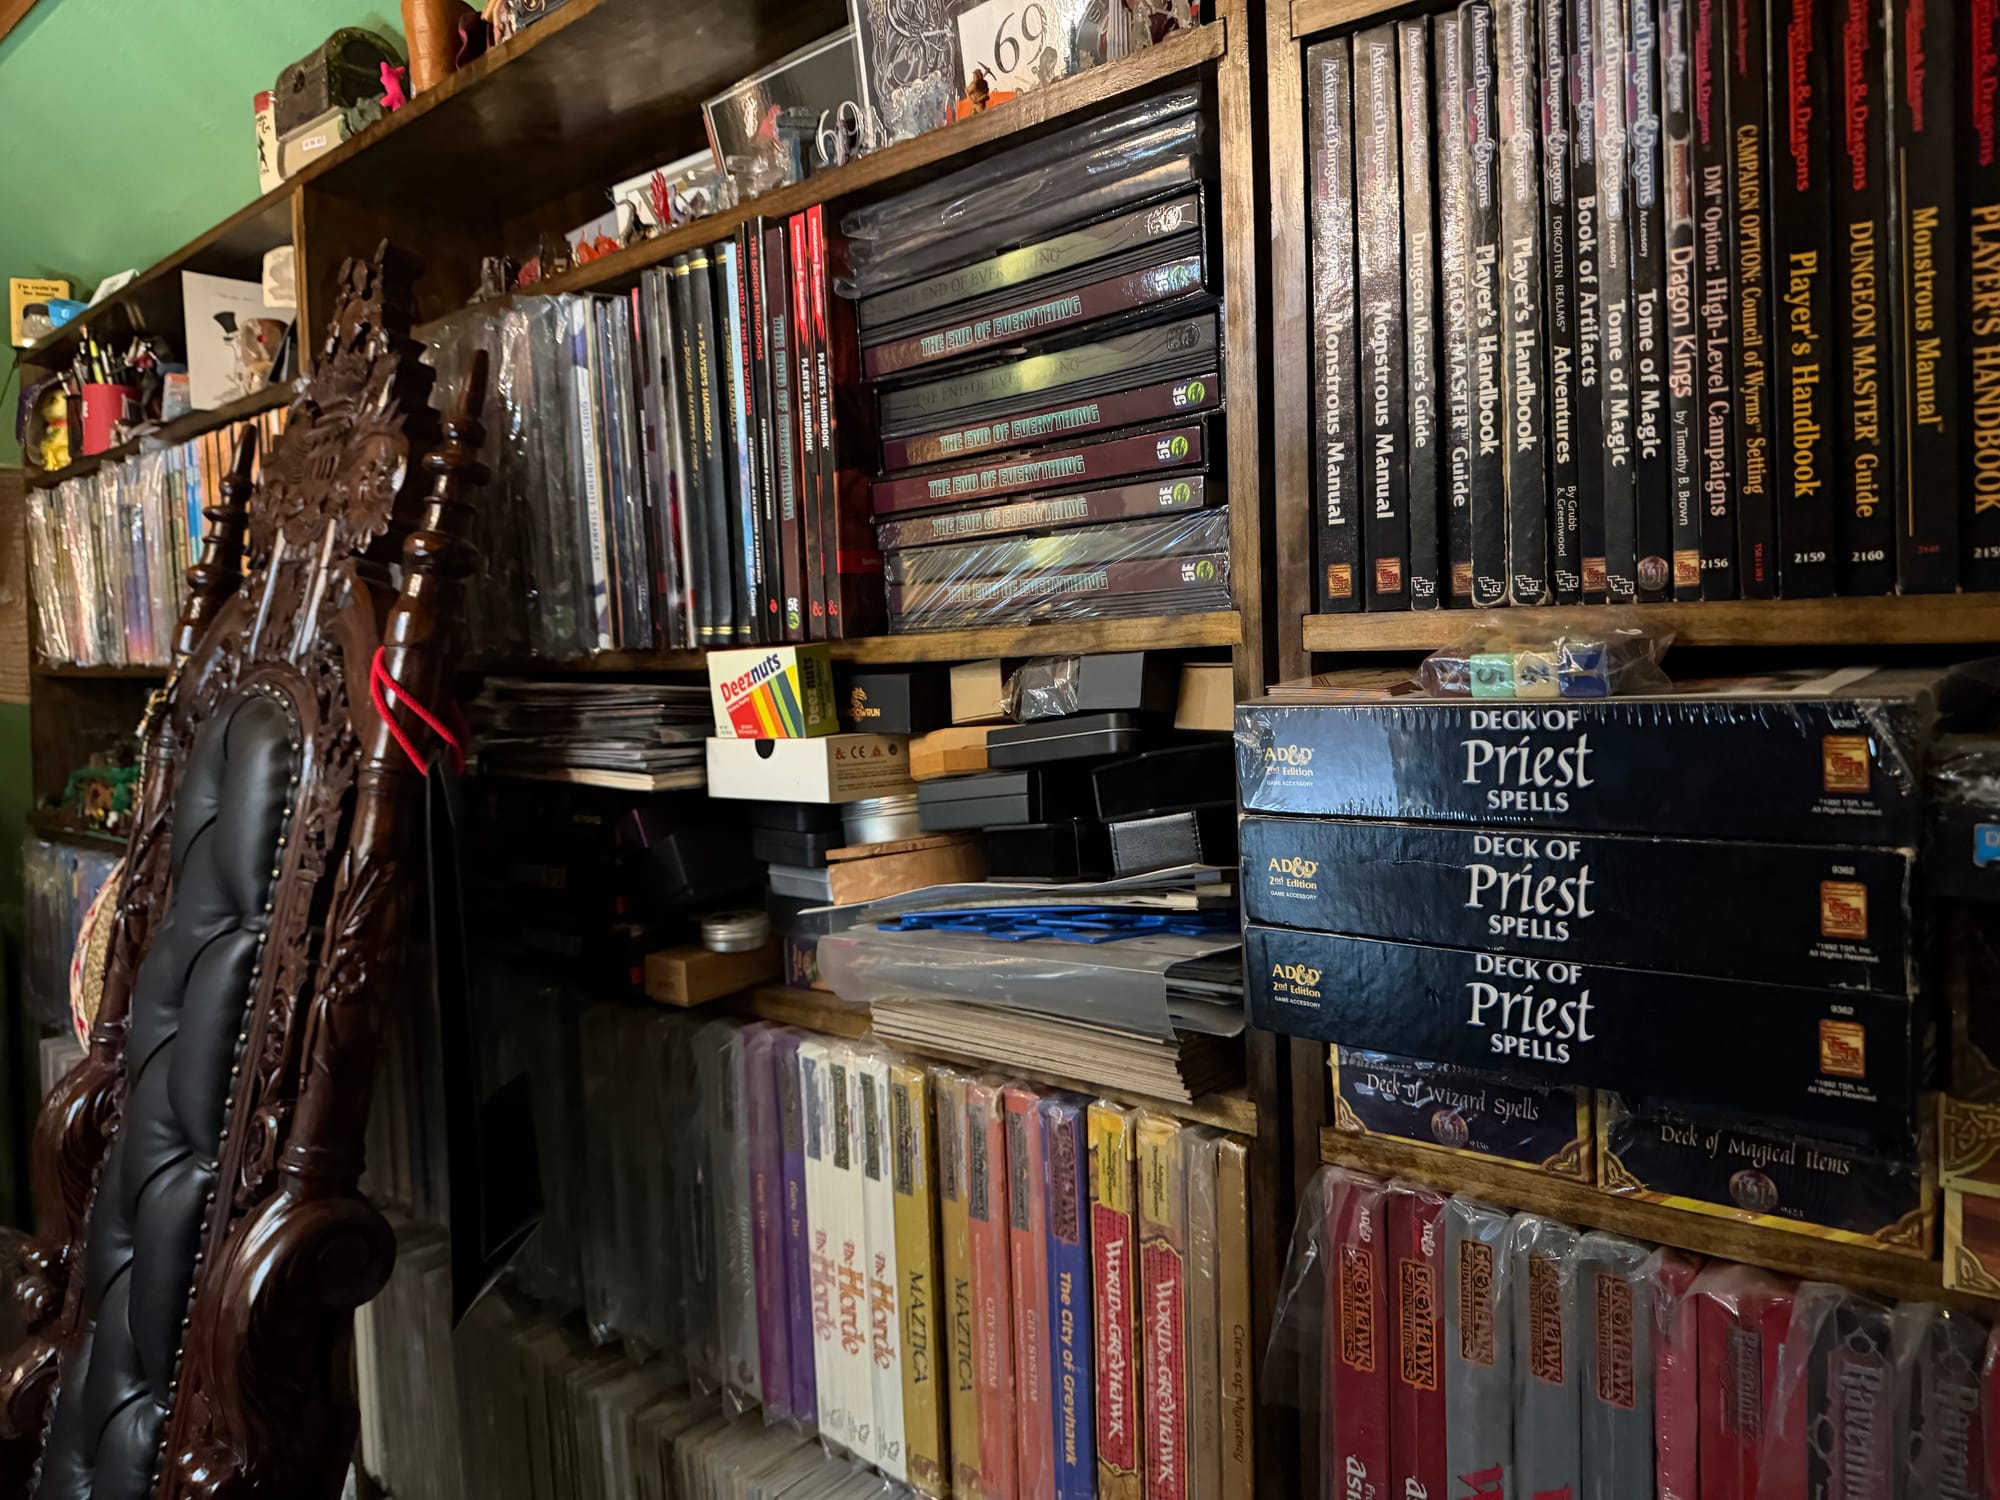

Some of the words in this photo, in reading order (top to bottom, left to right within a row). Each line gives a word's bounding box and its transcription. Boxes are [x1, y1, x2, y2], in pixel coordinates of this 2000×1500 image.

[1409, 30, 1424, 84] Advanced
[1474, 8, 1489, 76] Advanced
[1633, 38, 1654, 121] Dungeons
[1474, 77, 1489, 144] Dungeons
[1474, 154, 1490, 208] Dragons
[1633, 134, 1654, 205] Dragons
[1736, 124, 1759, 211] CAMPAIGN
[1577, 194, 1597, 255] Book
[1608, 222, 1618, 269] Accessory
[1639, 210, 1649, 258] Accessory
[1701, 206, 1723, 272] Option:
[1739, 213, 1761, 283] OPTION:
[738, 275, 746, 303] LAND
[751, 260, 760, 303] BORDER
[1410, 231, 1427, 315] Dungeon
[1472, 245, 1496, 328] Player's
[1512, 236, 1535, 324] Player's
[1578, 258, 1598, 284] of
[1667, 246, 1694, 327] Dragon
[1849, 219, 1877, 339] DUNGEON
[740, 305, 747, 321] OF
[754, 304, 763, 360] KINGDOMS
[773, 314, 784, 348] THE
[921, 335, 943, 357] THE
[946, 329, 971, 351] END
[975, 322, 992, 342] OF
[994, 295, 1082, 337] EVERYTHING
[1607, 299, 1626, 362] Tome
[1638, 288, 1658, 353] Tome
[1742, 286, 1762, 350] Council
[1784, 250, 1818, 358] Player's
[742, 345, 750, 366] RED
[1373, 300, 1393, 428] Monstrous
[1412, 315, 1430, 393] Master's
[1579, 290, 1601, 388] Artifacts
[1702, 277, 1729, 395] High-Level
[1744, 352, 1763, 369] of
[743, 366, 753, 417] WIZARDS
[775, 351, 787, 387] END
[801, 358, 811, 399] PLAYER'S
[1326, 311, 1345, 437] Monstrous
[1515, 329, 1538, 453] Handbook
[1609, 365, 1628, 393] of
[1640, 355, 1660, 384] of
[1668, 333, 1697, 398] Kings
[581, 401, 590, 439] QUESTS
[702, 388, 712, 442] HANDBOOK
[777, 390, 788, 412] OF
[1414, 394, 1431, 449] Guide
[1478, 335, 1500, 457] Handbook
[1554, 345, 1570, 466] Adventures
[1675, 410, 1688, 428] by
[939, 433, 962, 454] THE
[964, 427, 991, 450] END
[993, 423, 1010, 443] OF
[1012, 403, 1100, 440] EVERYTHING
[1606, 398, 1631, 467] Magic
[1637, 388, 1662, 461] Magic
[1675, 428, 1689, 475] Timothy
[1791, 363, 1822, 499] Handbook
[778, 414, 793, 521] EVERYTHING
[1327, 441, 1346, 526] Manual
[1375, 432, 1395, 519] Manual
[1677, 478, 1688, 489] B.
[1705, 399, 1731, 517] Campaigns
[1743, 436, 1767, 496] Setting
[1855, 452, 1881, 518] Guide
[1567, 485, 1576, 498] By
[1567, 500, 1577, 532] Grubb
[1678, 493, 1690, 526] Brown
[1700, 559, 1729, 569] 2156
[1794, 551, 1826, 564] 2159
[1852, 550, 1885, 563] 2160
[787, 597, 798, 612] 5E
[720, 653, 781, 703] Deeznuts
[1470, 709, 1535, 731] DECK
[1542, 709, 1580, 731] OF
[1264, 765, 1281, 777] 2nd
[1283, 766, 1314, 777] Edition
[1266, 779, 1281, 787] GAME
[1282, 779, 1314, 788] ACCESSORY
[1461, 733, 1595, 789] Priest
[1487, 789, 1569, 812] SPELLS
[1474, 835, 1538, 859] DECK
[1545, 839, 1581, 862] OF
[1832, 864, 1855, 876] 9362
[1269, 875, 1285, 886] 2nd
[1286, 878, 1318, 890] Edition
[1270, 889, 1286, 897] GAME
[1286, 891, 1318, 901] ACCESSORY
[1464, 860, 1596, 919] Priest
[1488, 914, 1570, 942] SPELLS
[1475, 953, 1541, 979] DECK
[1547, 962, 1582, 985] OF
[1465, 981, 1596, 1042] Priest
[1490, 1033, 1571, 1065] SPELLS
[1366, 1073, 1399, 1096] Deck
[1402, 1079, 1421, 1106] of
[1427, 1084, 1486, 1112] Wizard
[1494, 1098, 1540, 1122] Spells
[1660, 1123, 1697, 1148] Deck
[1706, 1129, 1723, 1160] of
[1728, 1138, 1796, 1169] Magical
[1806, 1150, 1850, 1176] Items
[1359, 1206, 1372, 1242] AD&D
[811, 1252, 836, 1341] Horde
[1061, 1271, 1073, 1305] The
[1104, 1238, 1123, 1312] WORLD
[838, 1265, 865, 1355] Horde
[871, 1277, 896, 1369] Horde
[909, 1270, 928, 1384] MAZTICA
[955, 1278, 973, 1392] MAZTICA
[986, 1297, 995, 1330] CITY
[1027, 1309, 1036, 1342] CITY
[1061, 1308, 1074, 1347] City
[1155, 1279, 1174, 1350] WORLD
[987, 1331, 997, 1389] SYSTEM
[1028, 1343, 1038, 1402] SYSTEM
[1063, 1349, 1075, 1371] of
[1233, 1323, 1246, 1369] Cities
[1108, 1322, 1125, 1440] GREYHAWK
[1231, 1371, 1245, 1394] of
[1063, 1374, 1078, 1467] Greyhawk
[1157, 1361, 1176, 1484] GREYHAWK
[1232, 1396, 1246, 1464] Mystery
[1837, 1362, 1885, 1500] Ravenlo
